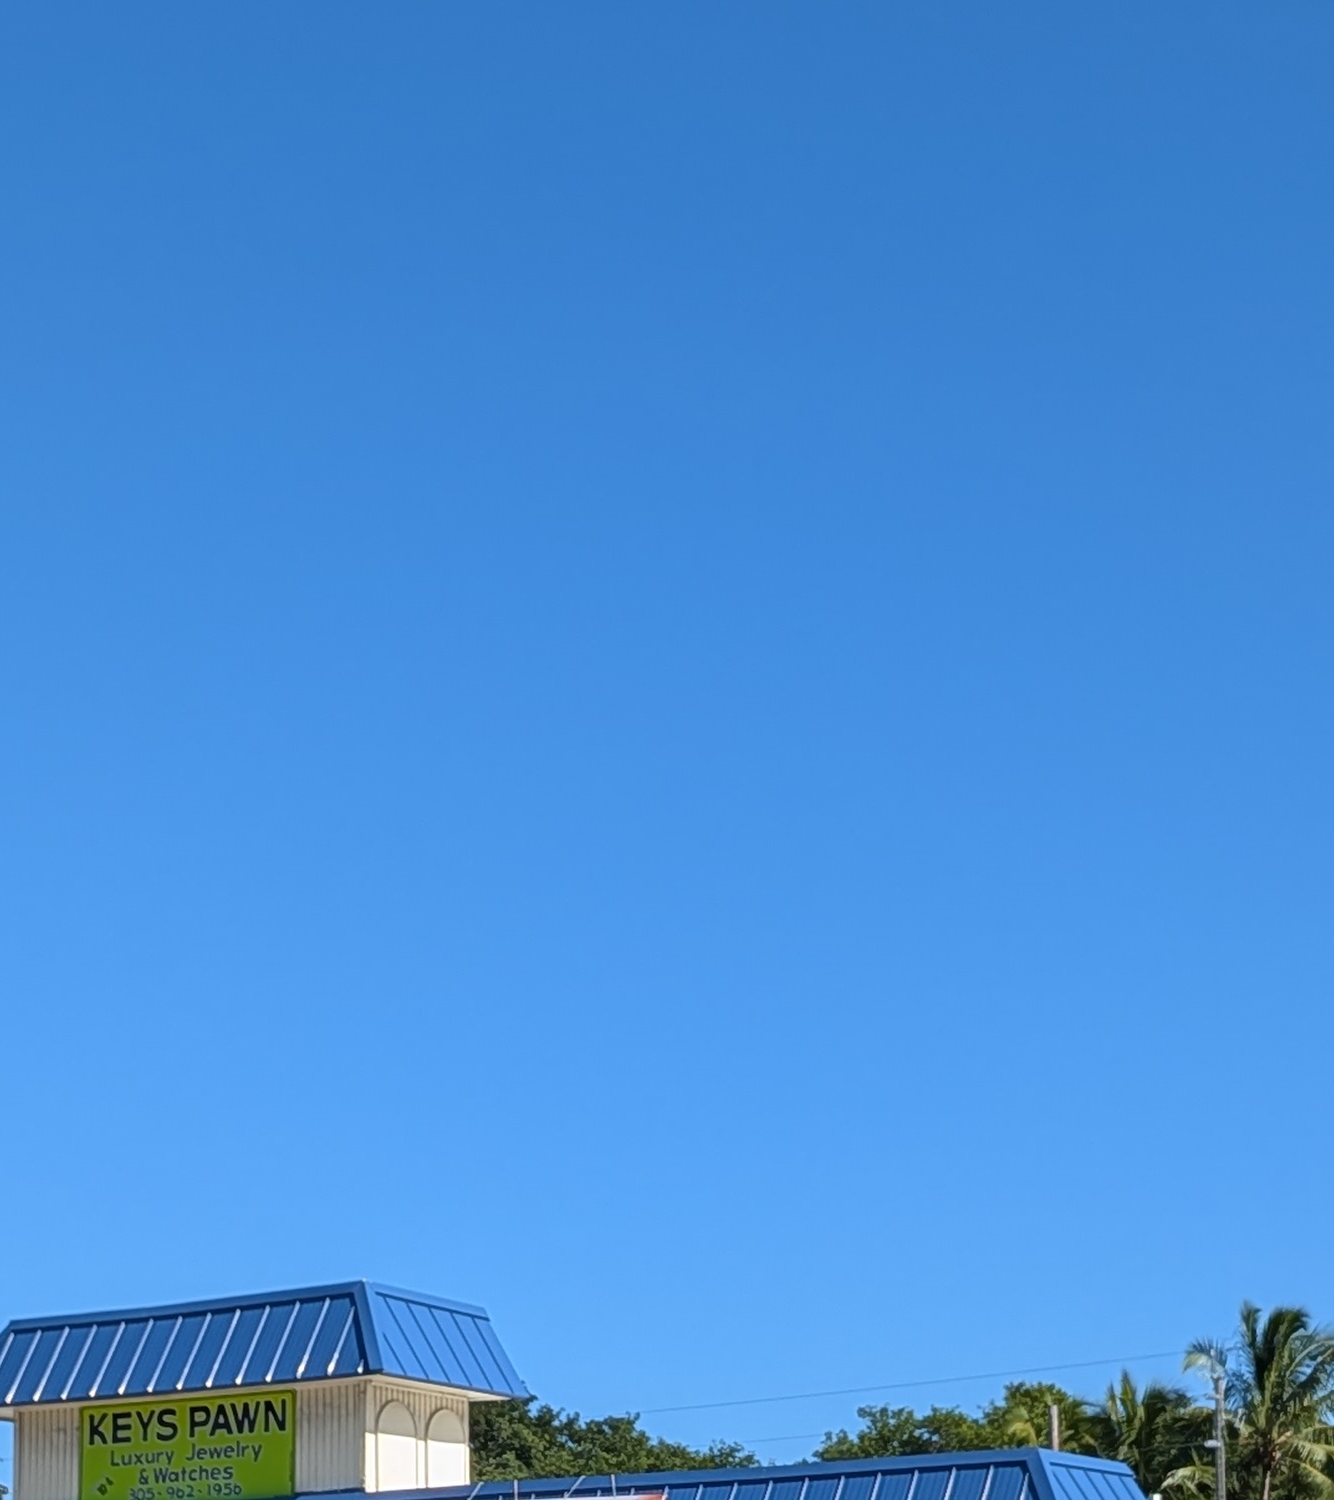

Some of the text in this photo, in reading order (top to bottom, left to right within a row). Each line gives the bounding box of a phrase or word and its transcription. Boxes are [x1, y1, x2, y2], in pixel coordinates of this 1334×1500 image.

[88, 1398, 287, 1446] KEYS PAWN
[110, 1441, 262, 1467] Luxury Jewelry
[138, 1465, 234, 1486] & Watches
